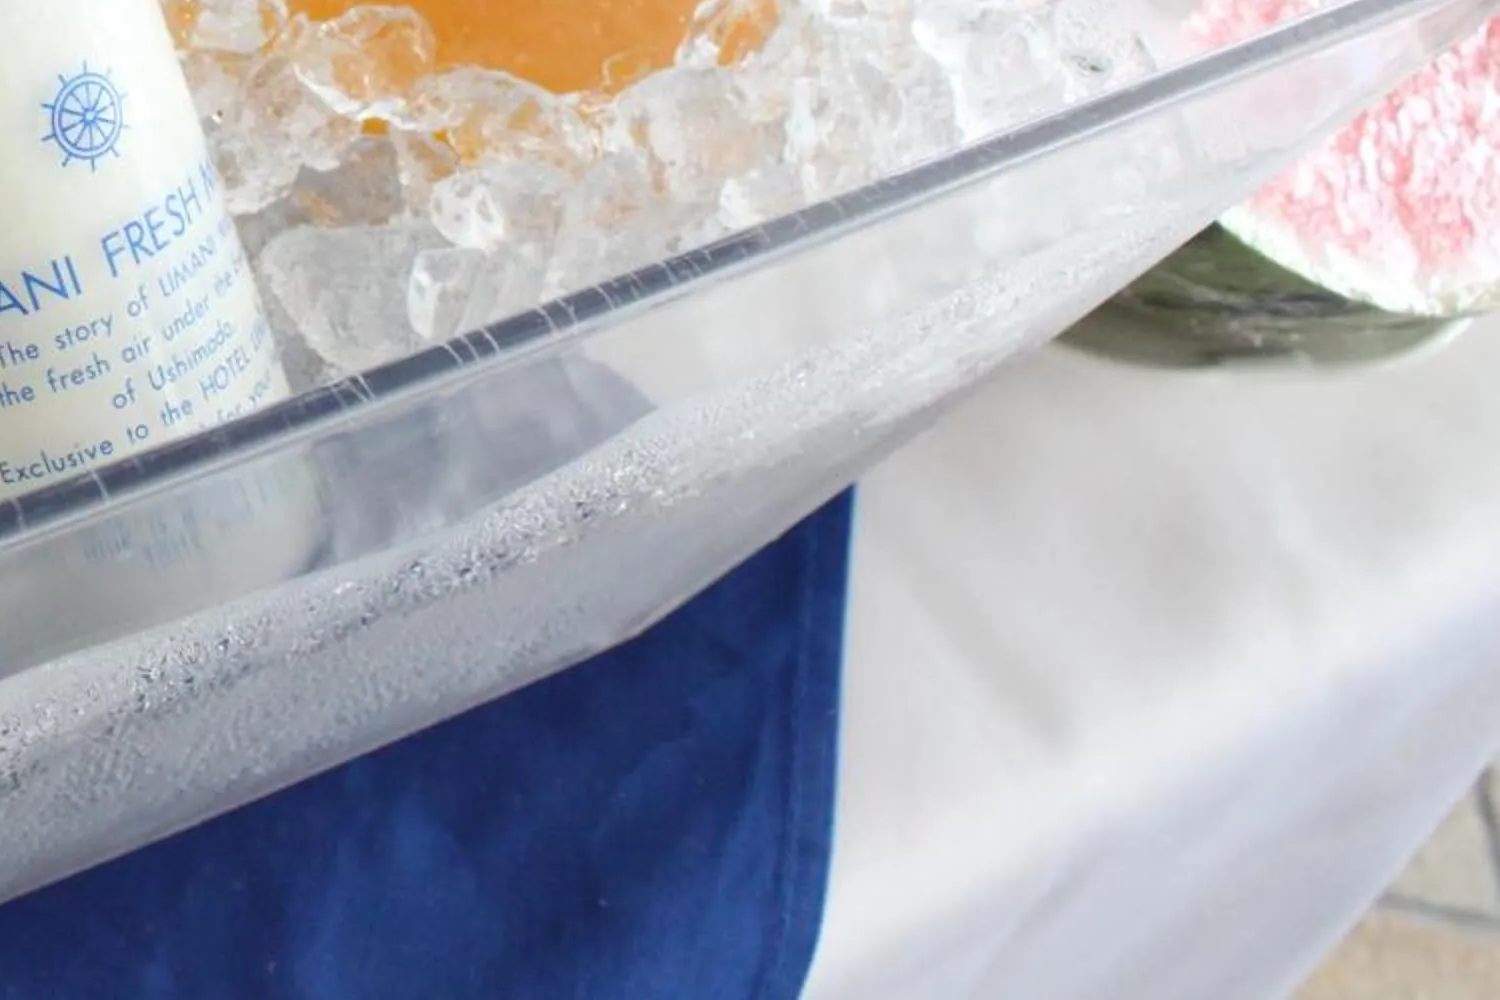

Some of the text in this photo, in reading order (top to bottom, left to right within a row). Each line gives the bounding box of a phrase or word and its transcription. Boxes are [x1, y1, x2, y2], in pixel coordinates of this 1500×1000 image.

[100, 176, 203, 278] FRESH
[47, 353, 111, 393] fresh
[121, 334, 151, 364] air
[162, 294, 210, 342] under
[54, 315, 113, 350] story
[126, 286, 150, 318] of
[112, 378, 137, 411] of
[147, 318, 235, 392] Ushimado
[126, 421, 149, 446] to
[161, 398, 194, 426] the
[199, 344, 251, 402] HOTEL
